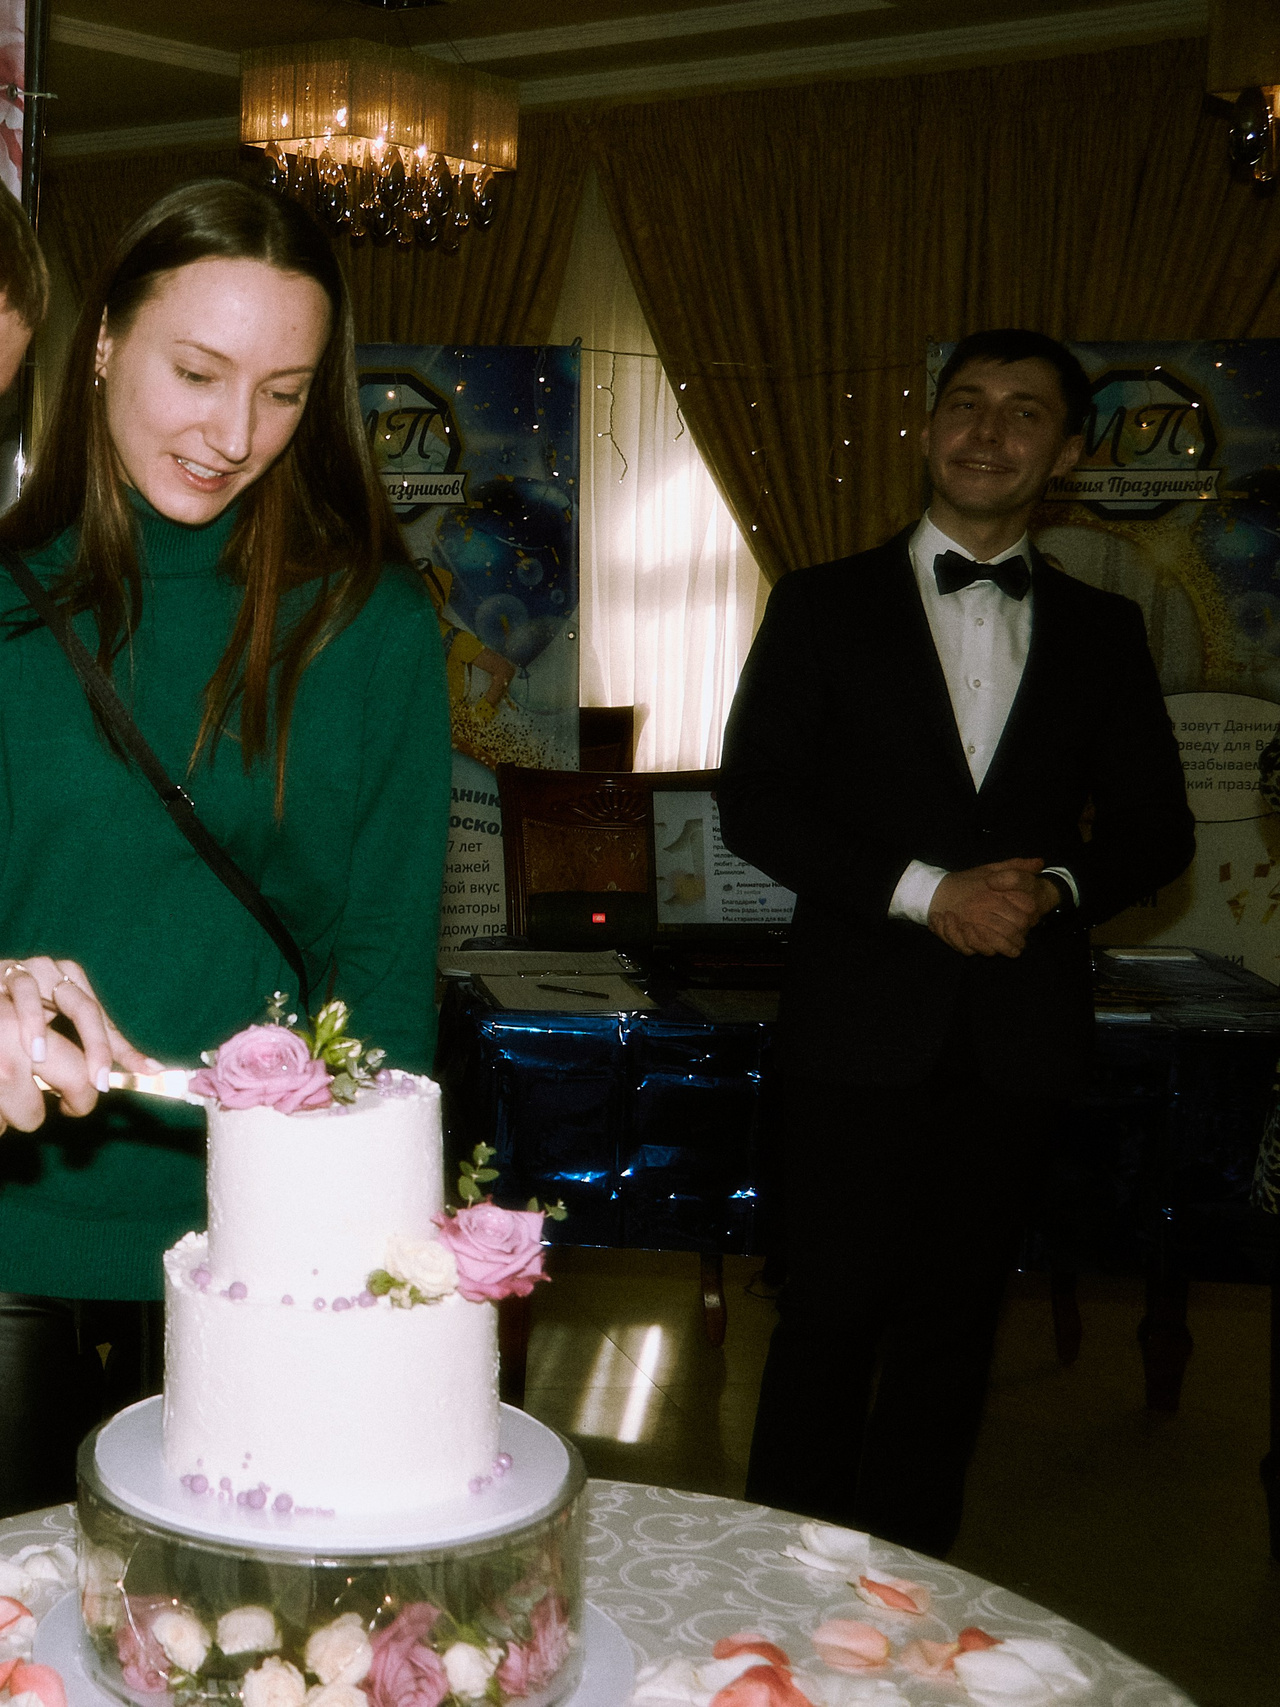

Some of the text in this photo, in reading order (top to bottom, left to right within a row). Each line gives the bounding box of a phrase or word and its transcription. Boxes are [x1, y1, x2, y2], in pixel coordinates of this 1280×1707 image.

[1046, 475, 1214, 497] Магия Праздников
[1180, 722, 1221, 734] зовут
[1223, 742, 1251, 752] для
[458, 842, 483, 853] лет
[470, 882, 500, 896] вкус
